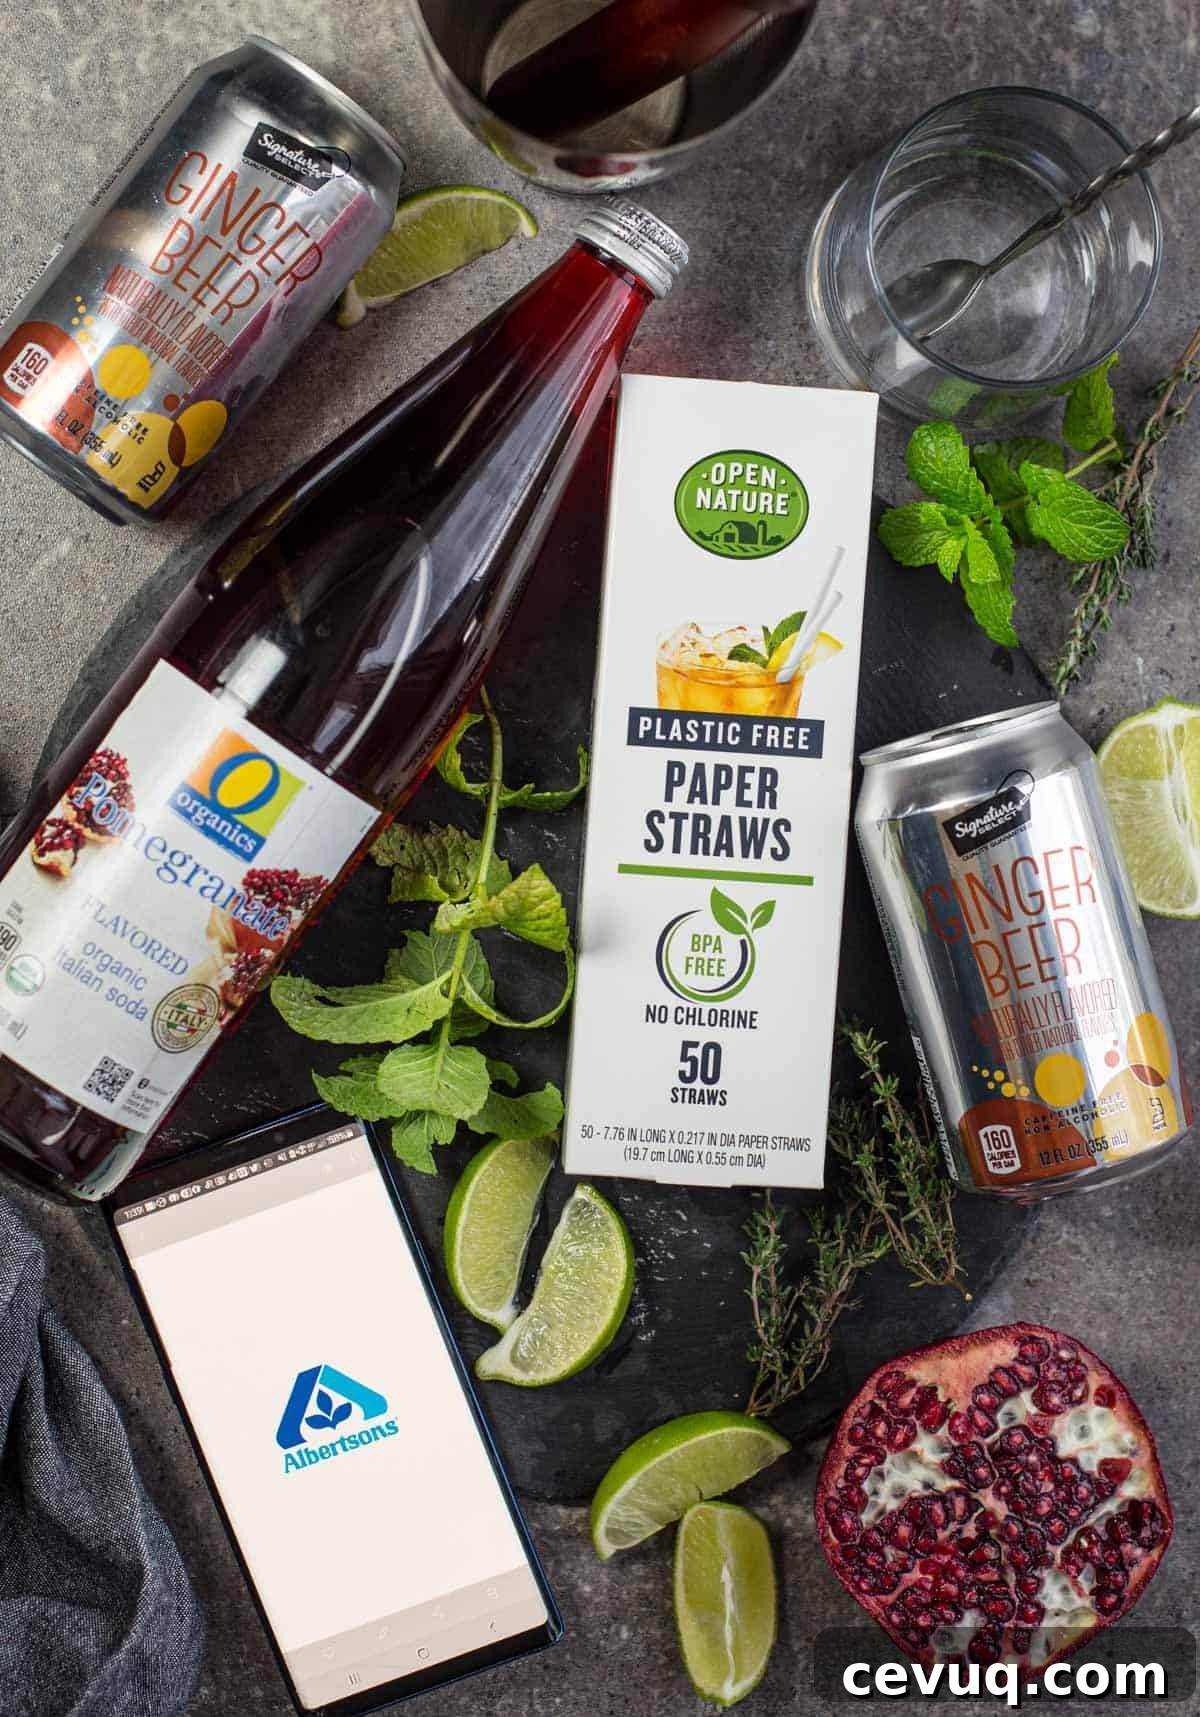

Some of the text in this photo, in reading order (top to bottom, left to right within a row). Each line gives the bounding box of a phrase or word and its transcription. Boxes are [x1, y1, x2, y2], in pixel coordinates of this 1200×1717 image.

[258, 133, 320, 173] Signature
[274, 154, 317, 178] SELECT
[164, 151, 323, 297] GINGER
[150, 219, 260, 327] BEER
[21, 347, 49, 375] 160
[710, 462, 778, 489] OPEN
[695, 486, 790, 516] NATURE
[637, 717, 811, 750] PLASTIC FREE
[664, 759, 781, 810] PAPER
[176, 792, 258, 854] organics
[643, 809, 792, 862] STRAWS
[954, 800, 1017, 839] Signature
[977, 810, 1017, 834] SELECT
[73, 772, 290, 942] Pomegranate
[924, 846, 1097, 944] GINGER
[82, 895, 190, 976] FLAVORED
[690, 933, 723, 954] BPA
[82, 941, 149, 991] organic
[684, 956, 725, 977] FREE
[971, 917, 1083, 999] BEER
[56, 944, 105, 993] Italian
[104, 986, 150, 1022] soda
[167, 1008, 208, 1027] ITALY
[645, 1004, 759, 1030] NO CHLORINE
[678, 1040, 722, 1085] 50
[670, 1086, 728, 1107] STRAWS
[581, 1125, 594, 1139] 50
[603, 1126, 625, 1141] 7.76
[627, 1128, 638, 1142] IN
[640, 1128, 665, 1143] LONG
[667, 1131, 676, 1145] X
[677, 1131, 704, 1147] 0.217
[706, 1133, 718, 1147] IN
[719, 1133, 737, 1149] DIA
[738, 1134, 769, 1150] PAPER
[770, 1136, 811, 1153] STRAWS
[622, 1146, 766, 1168] (19.7 cm LONG X 0.55 cm DIA)
[983, 1129, 1010, 1152] 160
[283, 1420, 399, 1473] Albertsons
